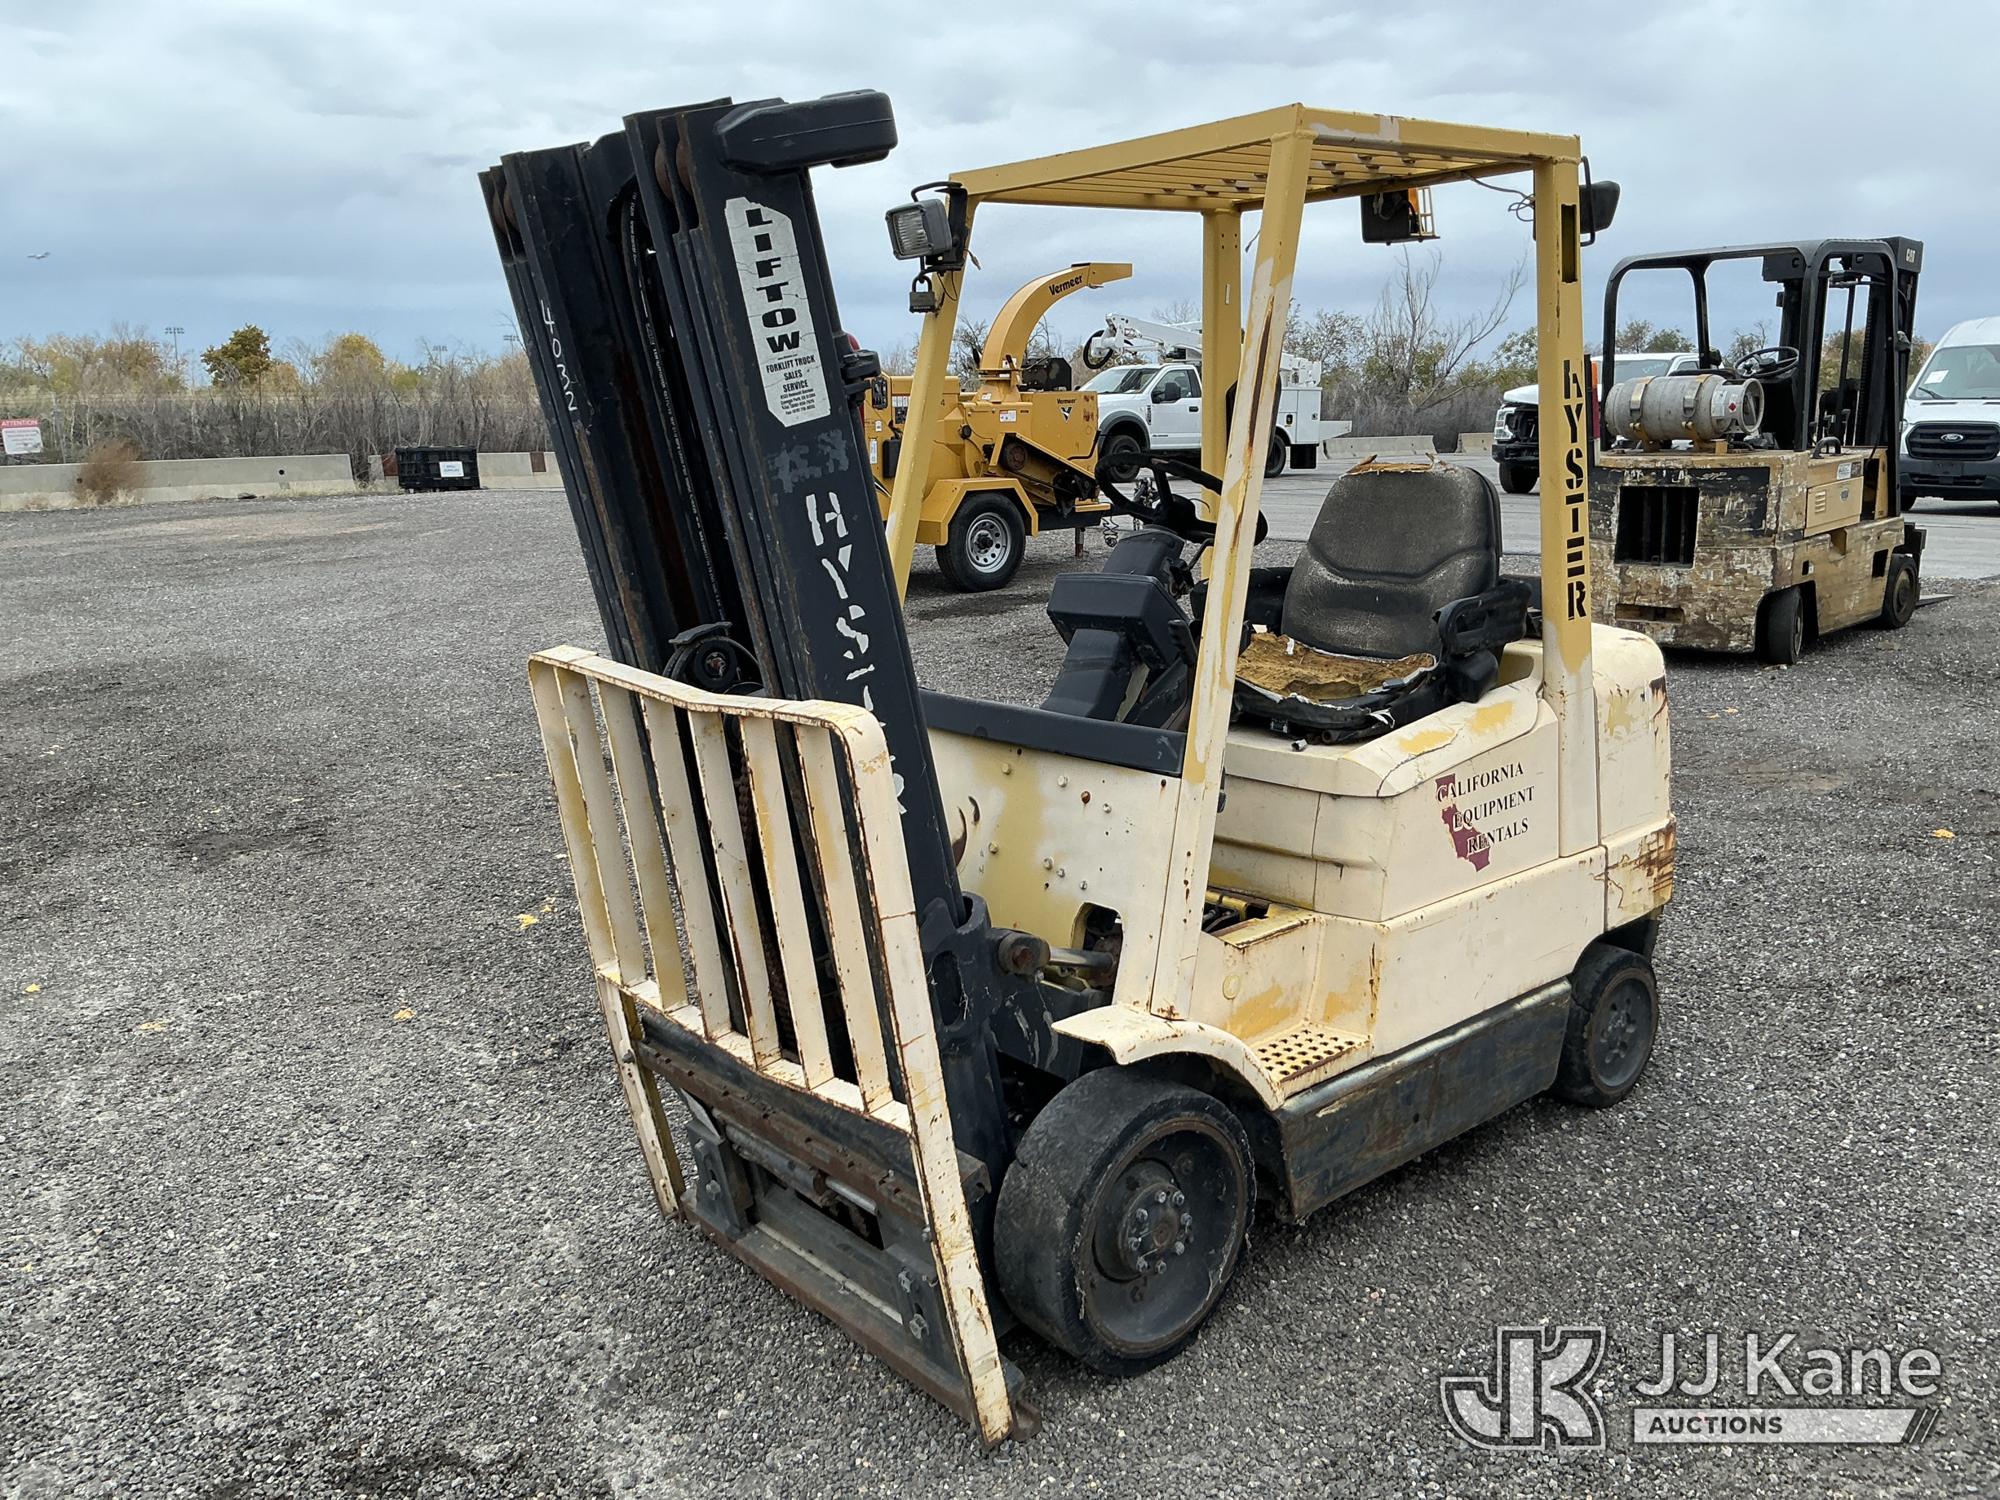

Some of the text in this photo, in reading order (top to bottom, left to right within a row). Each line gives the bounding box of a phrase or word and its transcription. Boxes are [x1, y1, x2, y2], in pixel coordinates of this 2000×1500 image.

[747, 208, 800, 353] LIFTOW
[1049, 275, 1083, 296] Vermeer
[541, 299, 577, 411] 4032
[766, 360, 793, 373] FORKLIFT
[794, 354, 816, 366] TRUCK
[783, 380, 808, 392] SERVICE
[784, 370, 802, 380] SALES
[1563, 359, 1587, 622] HYSTER
[1437, 761, 1524, 802] CALIFORNIA
[1454, 785, 1535, 830] EQUIPMENT
[1467, 817, 1529, 855] RENTALS
